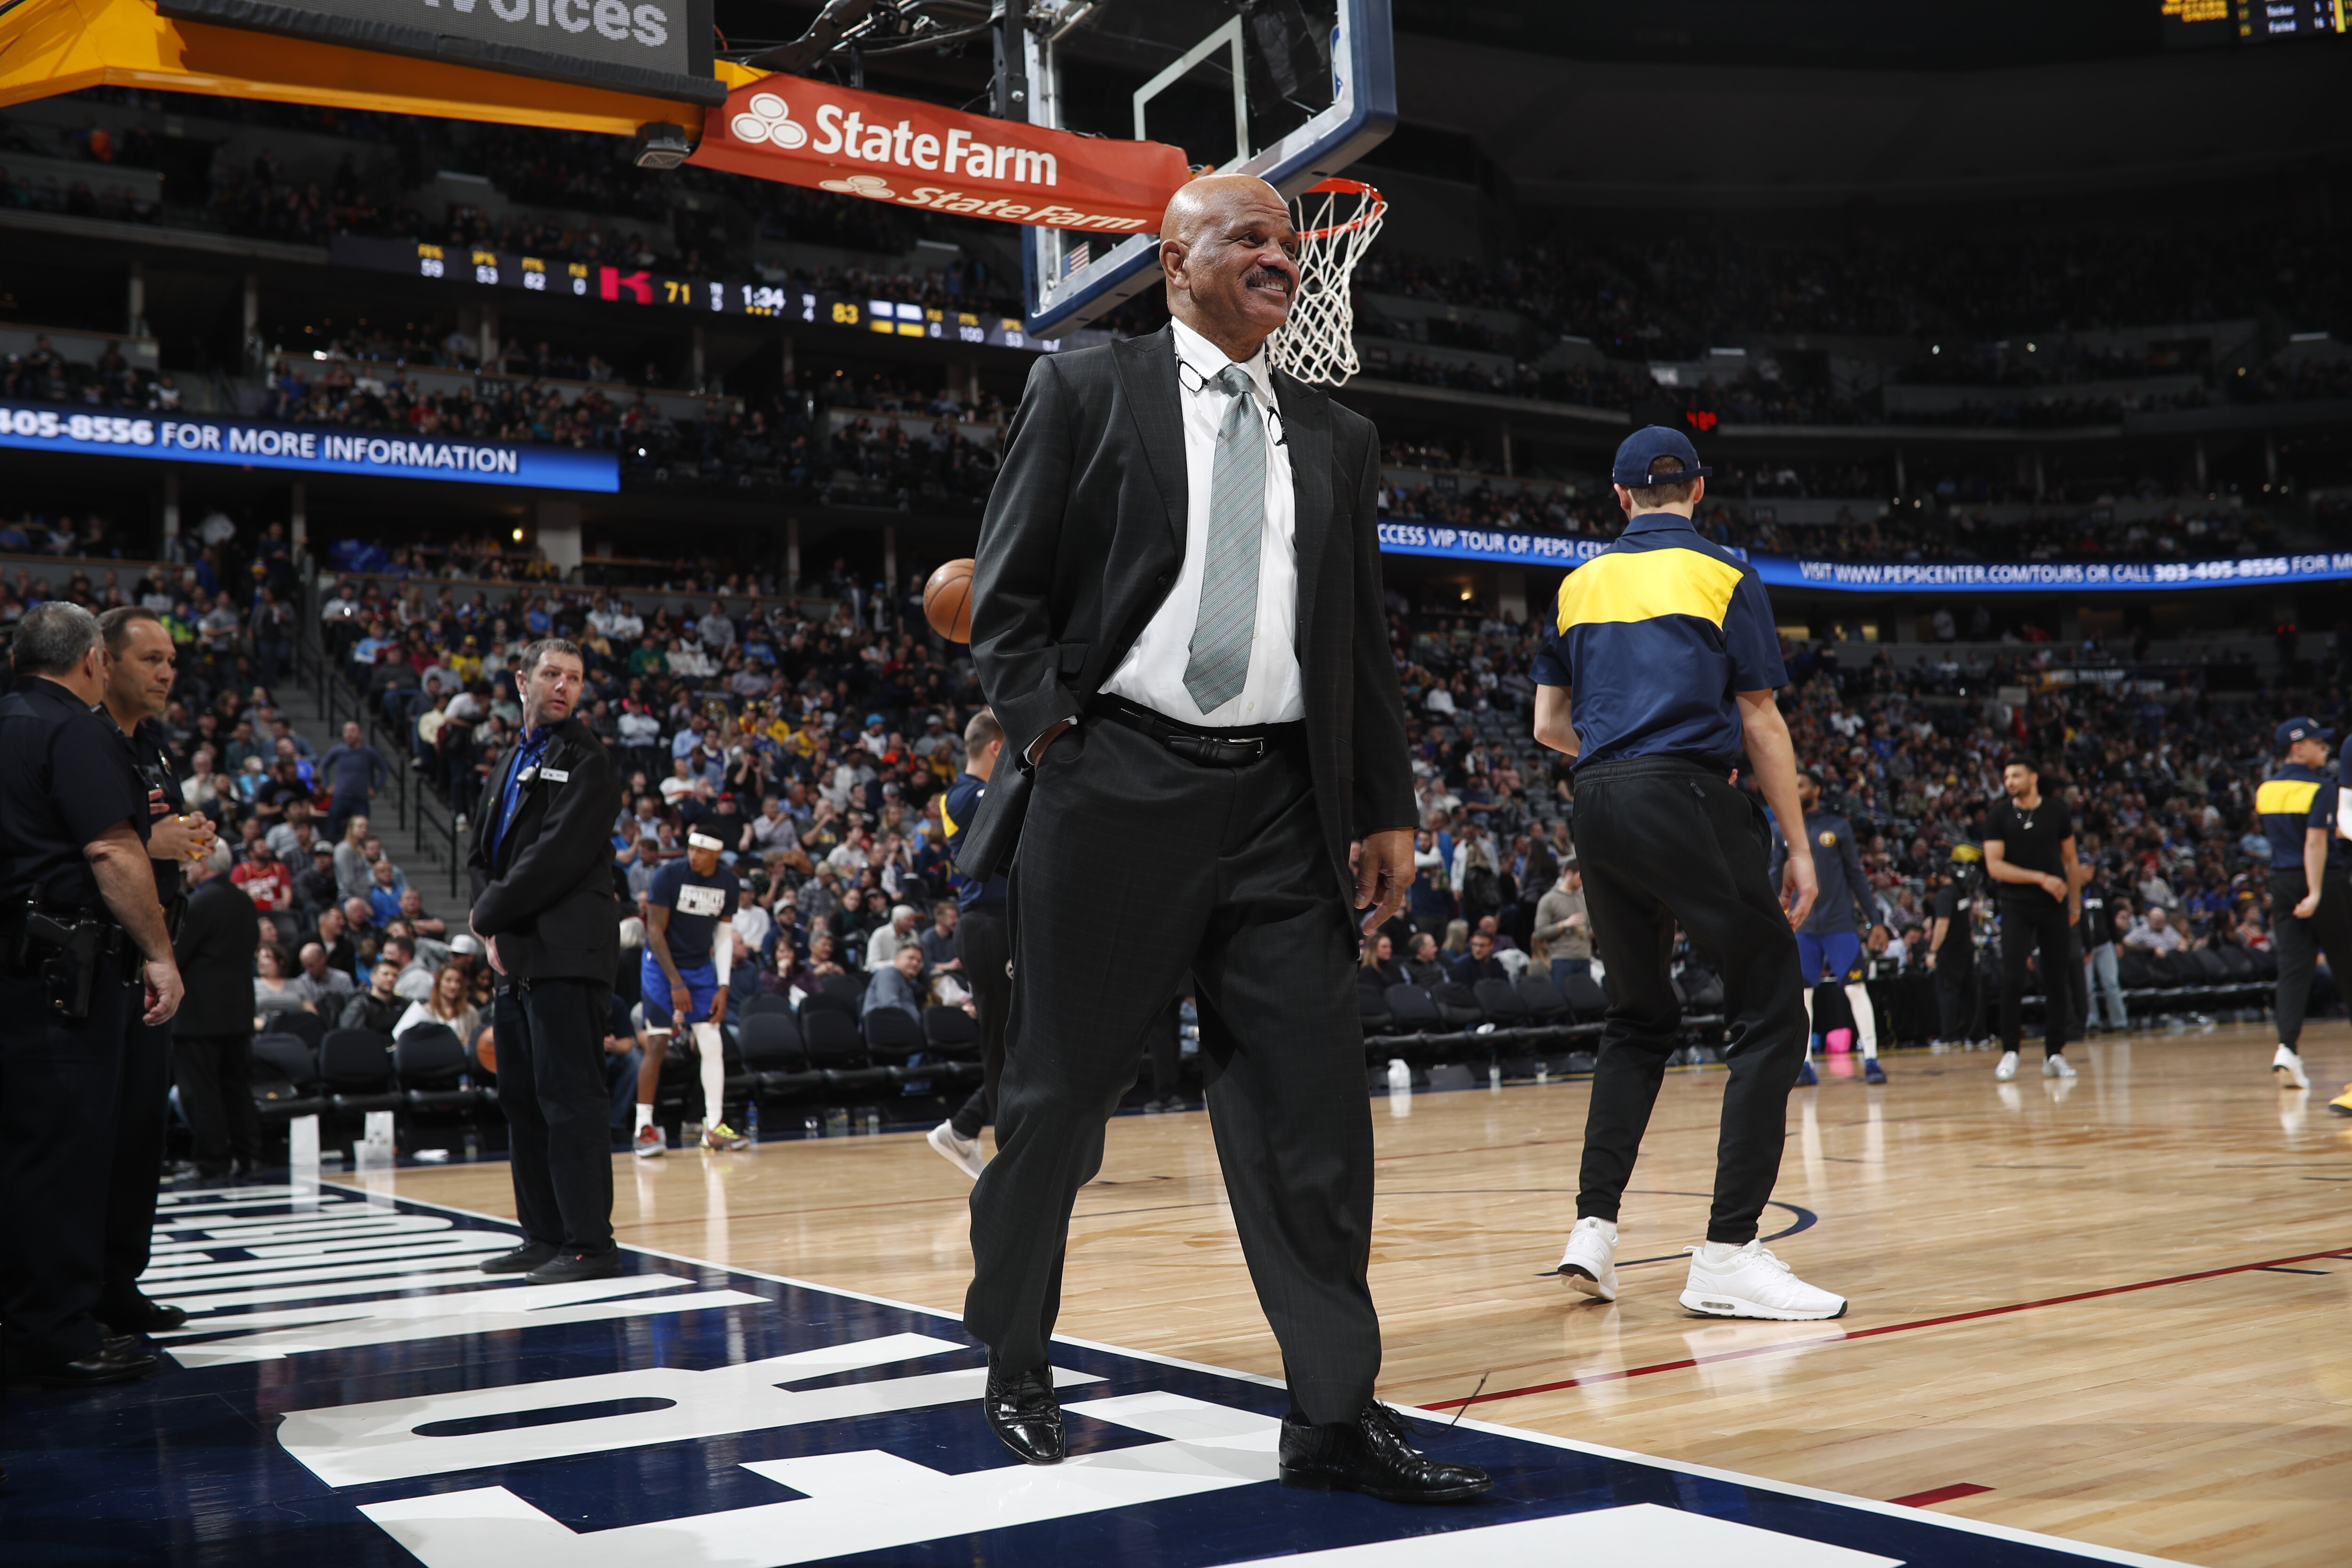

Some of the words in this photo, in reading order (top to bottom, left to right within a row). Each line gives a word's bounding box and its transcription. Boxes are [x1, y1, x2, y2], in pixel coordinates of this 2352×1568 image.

[453, 0, 667, 47] oices
[421, 258, 444, 278] 59
[664, 281, 690, 304] 71
[741, 284, 786, 310] 1:34
[832, 302, 859, 325] 83
[161, 422, 221, 451] FOR
[229, 427, 316, 459] MORE
[325, 435, 517, 474] INFORMATION
[1428, 528, 1456, 548] VIP
[1458, 530, 1506, 552] TOUR
[1508, 535, 1530, 554] OF
[1534, 537, 1574, 558] PEPSI
[1800, 561, 1832, 581] VISIT
[2086, 565, 2110, 583] OR
[2112, 564, 2151, 583] CALL
[2153, 557, 2289, 582] 303-405-8556
[2291, 555, 2329, 574] FOR
